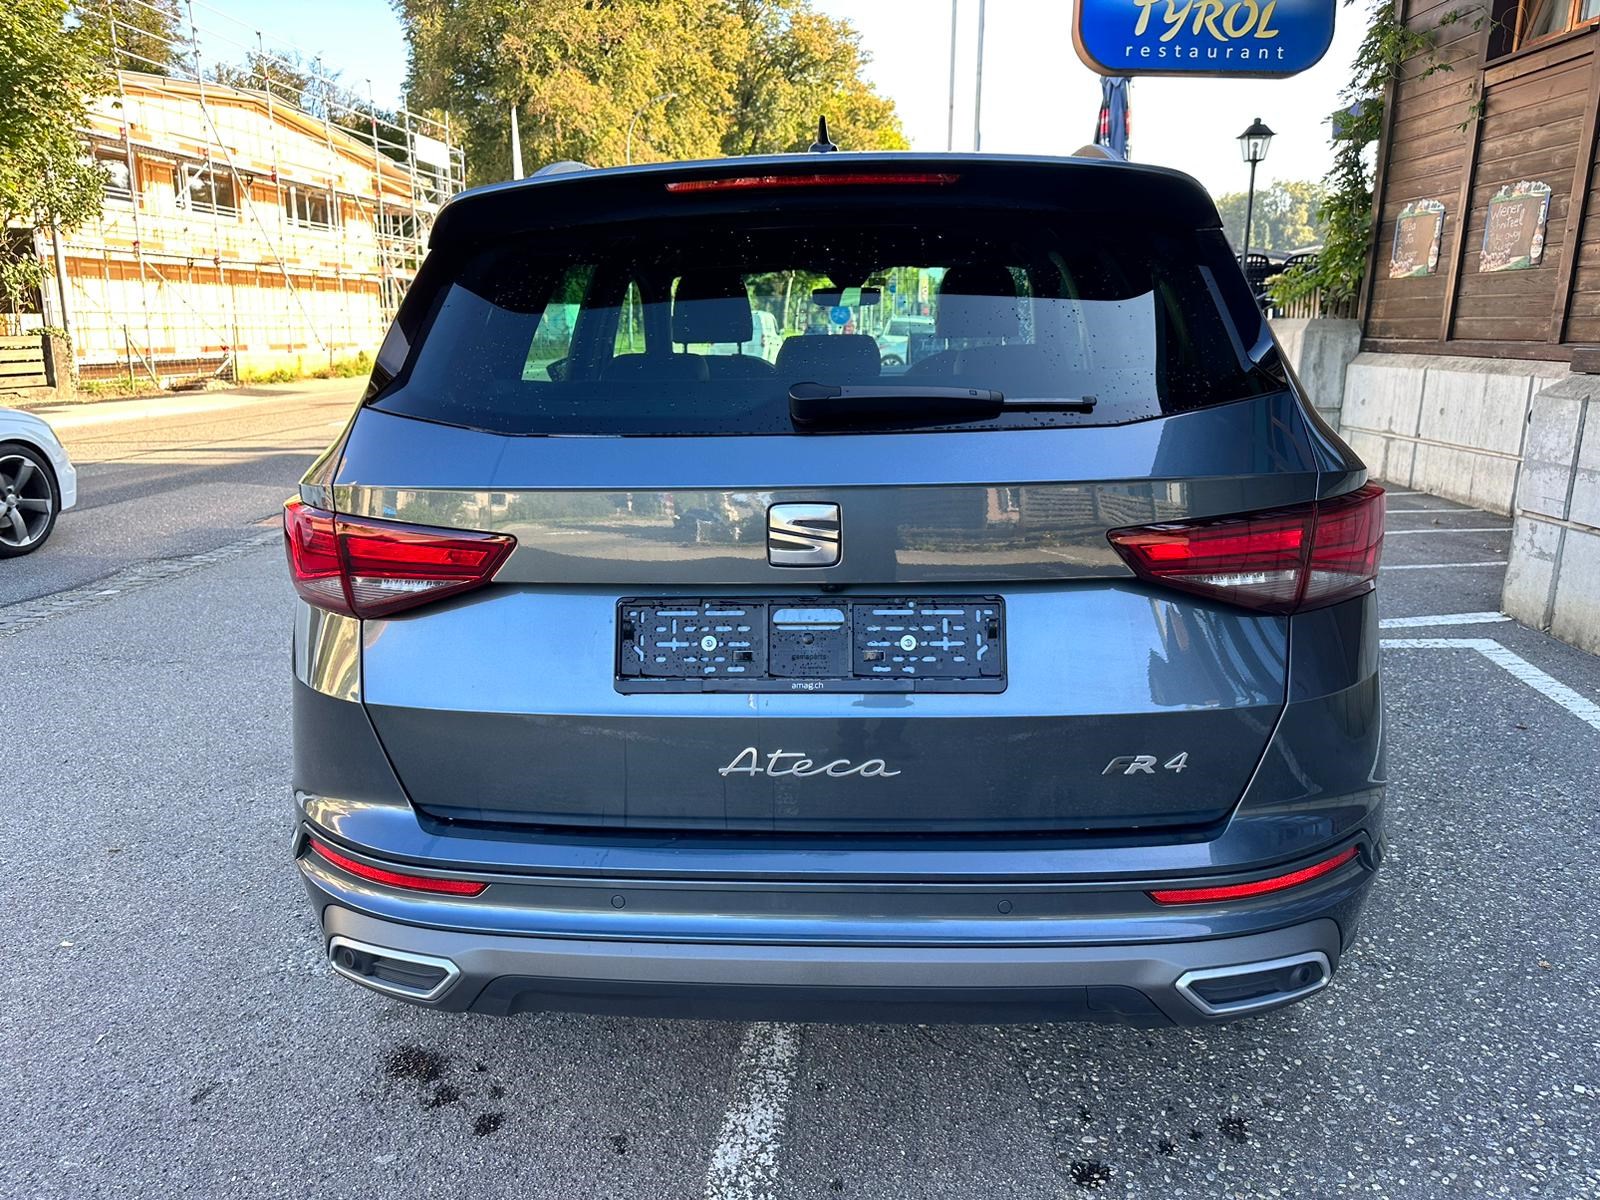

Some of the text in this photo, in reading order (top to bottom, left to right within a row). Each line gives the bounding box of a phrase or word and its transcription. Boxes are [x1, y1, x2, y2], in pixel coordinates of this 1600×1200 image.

[1132, 0, 1280, 42] TYROL
[1125, 44, 1285, 59] restaurant
[791, 682, 824, 691] amag.ch
[718, 747, 901, 777] Ateca
[1101, 751, 1189, 775] FR 4
